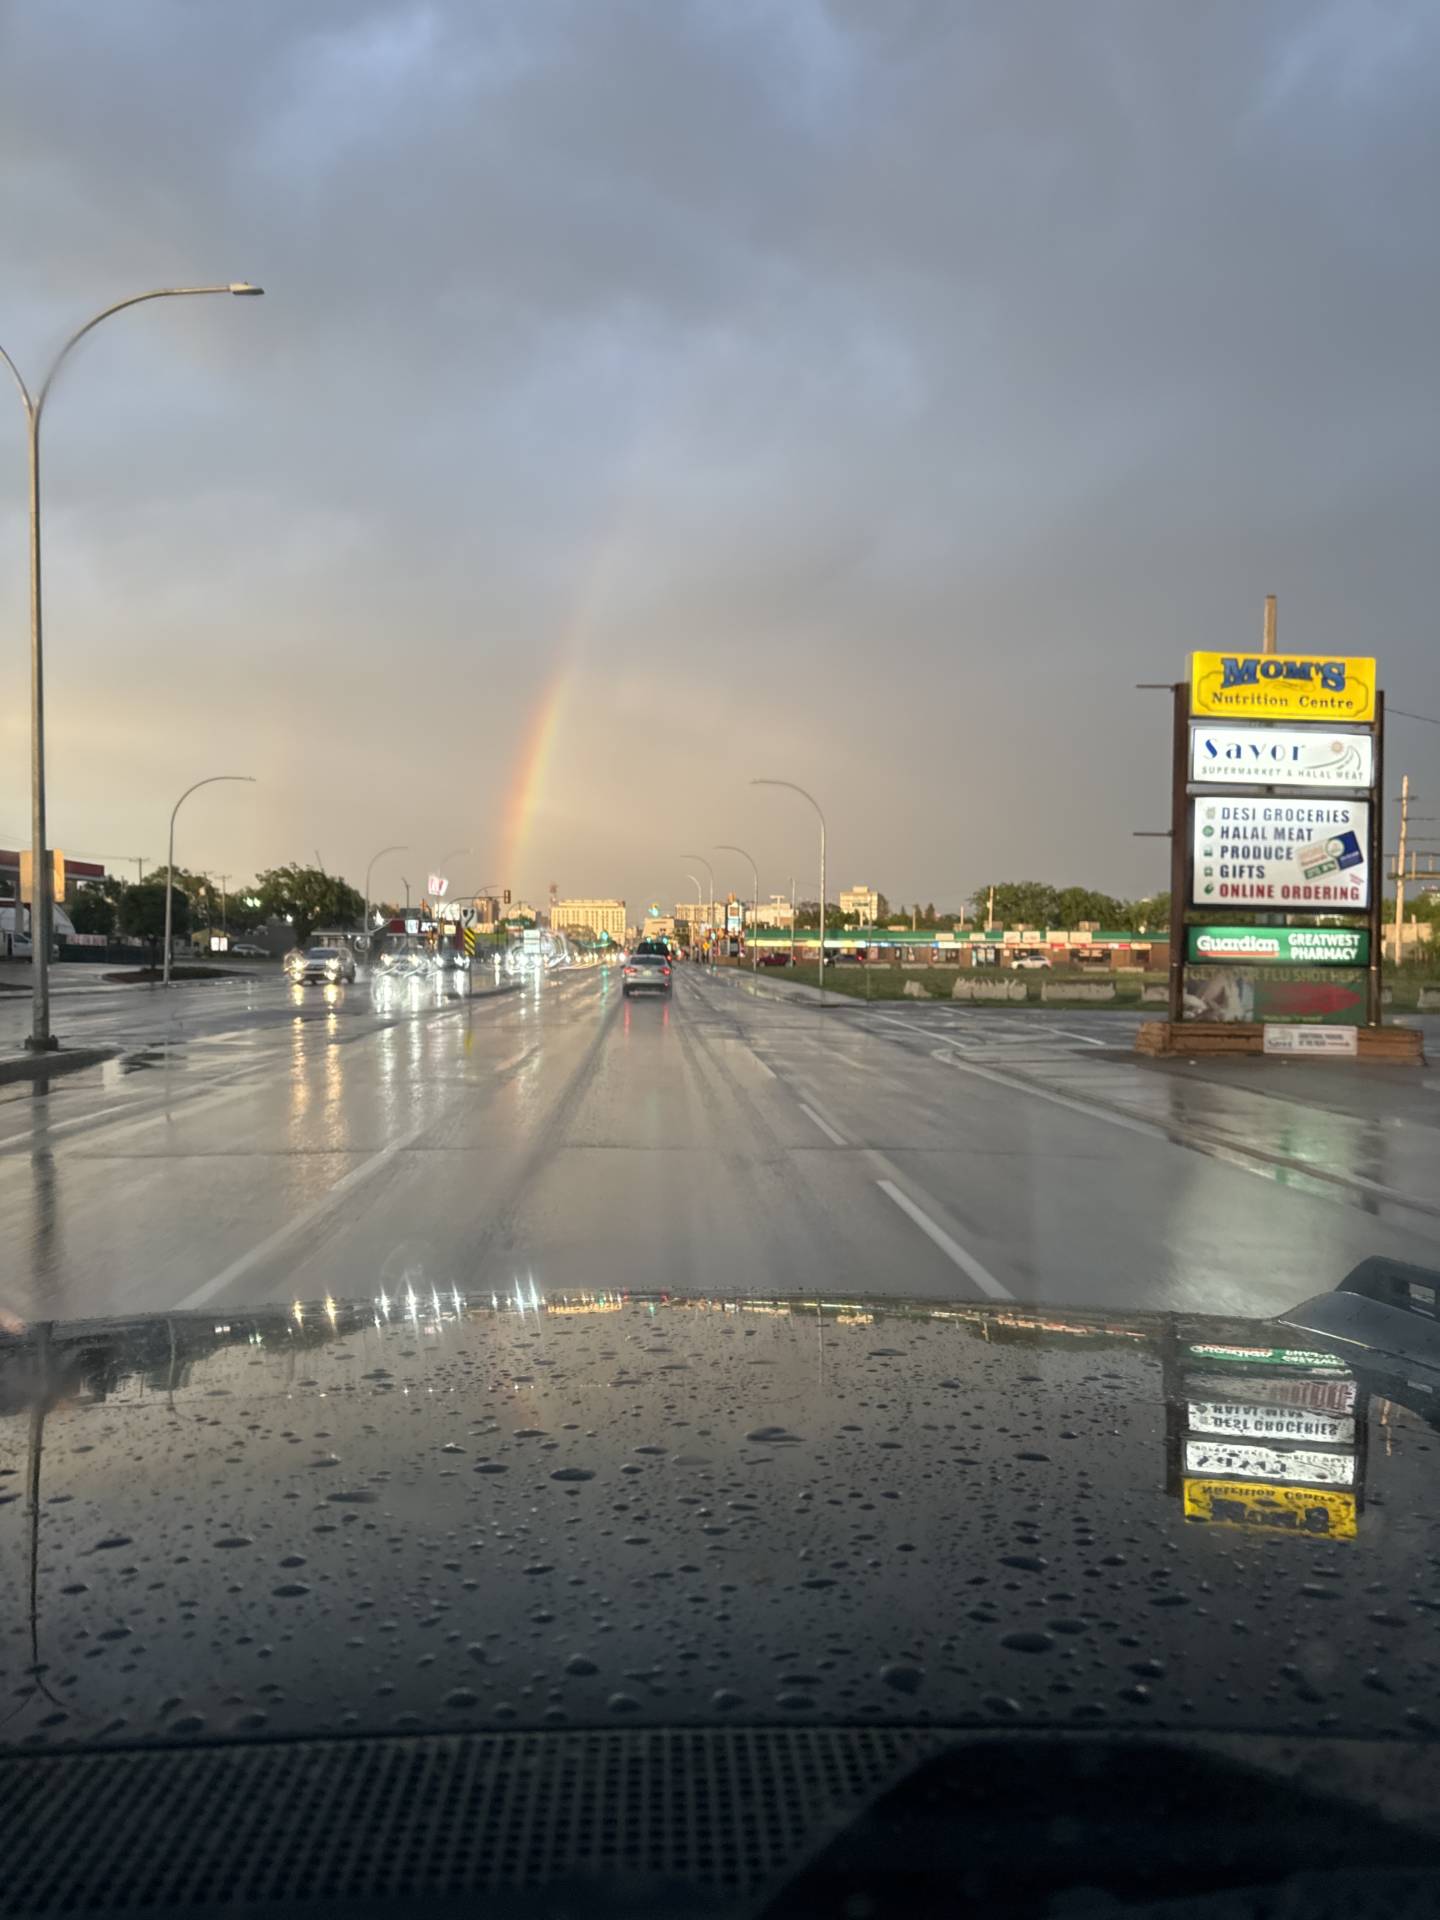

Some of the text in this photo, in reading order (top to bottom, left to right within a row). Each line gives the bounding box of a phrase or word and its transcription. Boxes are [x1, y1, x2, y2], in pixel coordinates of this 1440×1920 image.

[1221, 657, 1346, 692] MOM'S
[1212, 692, 1354, 709] Nutrition Centre
[1203, 738, 1306, 762] Savor
[1202, 766, 1281, 777] SUPERMARKET
[1298, 770, 1332, 779] HALAL
[1336, 771, 1364, 781] MEAT
[1221, 807, 1350, 824] DESI GROCERIES
[1220, 826, 1314, 842] HALAL MEAT
[1220, 845, 1294, 860] PRODUCE
[1219, 865, 1266, 879] GIFTS
[1219, 883, 1360, 901] ONLINE ORDERING
[1196, 935, 1280, 952] Guardian
[1288, 933, 1361, 947] GREATWEST
[1290, 947, 1358, 961] PHARMACY
[1263, 968, 1290, 981] FLU
